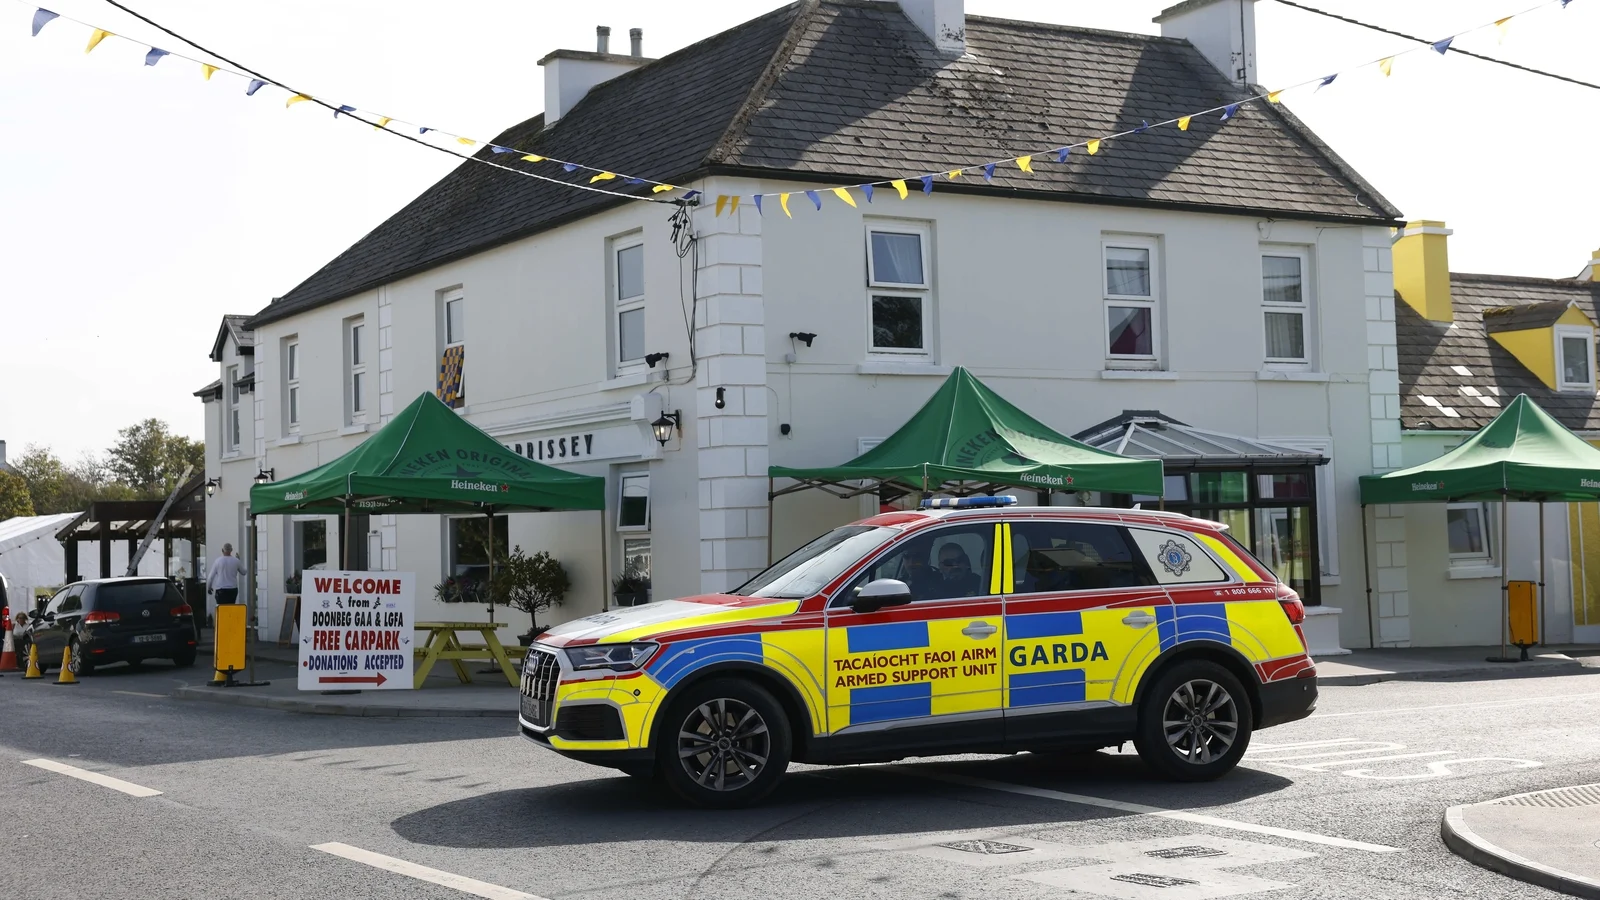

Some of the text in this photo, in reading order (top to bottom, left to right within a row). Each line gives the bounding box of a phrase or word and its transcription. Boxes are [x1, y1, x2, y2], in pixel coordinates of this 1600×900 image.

[505, 434, 593, 460] RRISSEY
[400, 448, 451, 477] NEKEN
[451, 480, 498, 492] Heineken
[1020, 473, 1063, 485] Heineken
[1412, 482, 1437, 491] Heineken
[314, 577, 401, 594] WELCOME
[348, 596, 370, 608] from
[312, 611, 404, 627] DOONBEG GAA & LGFA
[313, 630, 400, 651] FREE CARPARK
[308, 654, 405, 671] DONATIONS ACCEPTED
[833, 647, 997, 671] TACAÍOCHT FAOI AIRM
[1009, 641, 1109, 667] GARDA
[835, 663, 997, 688] ARMED SUPPORT UNIT
